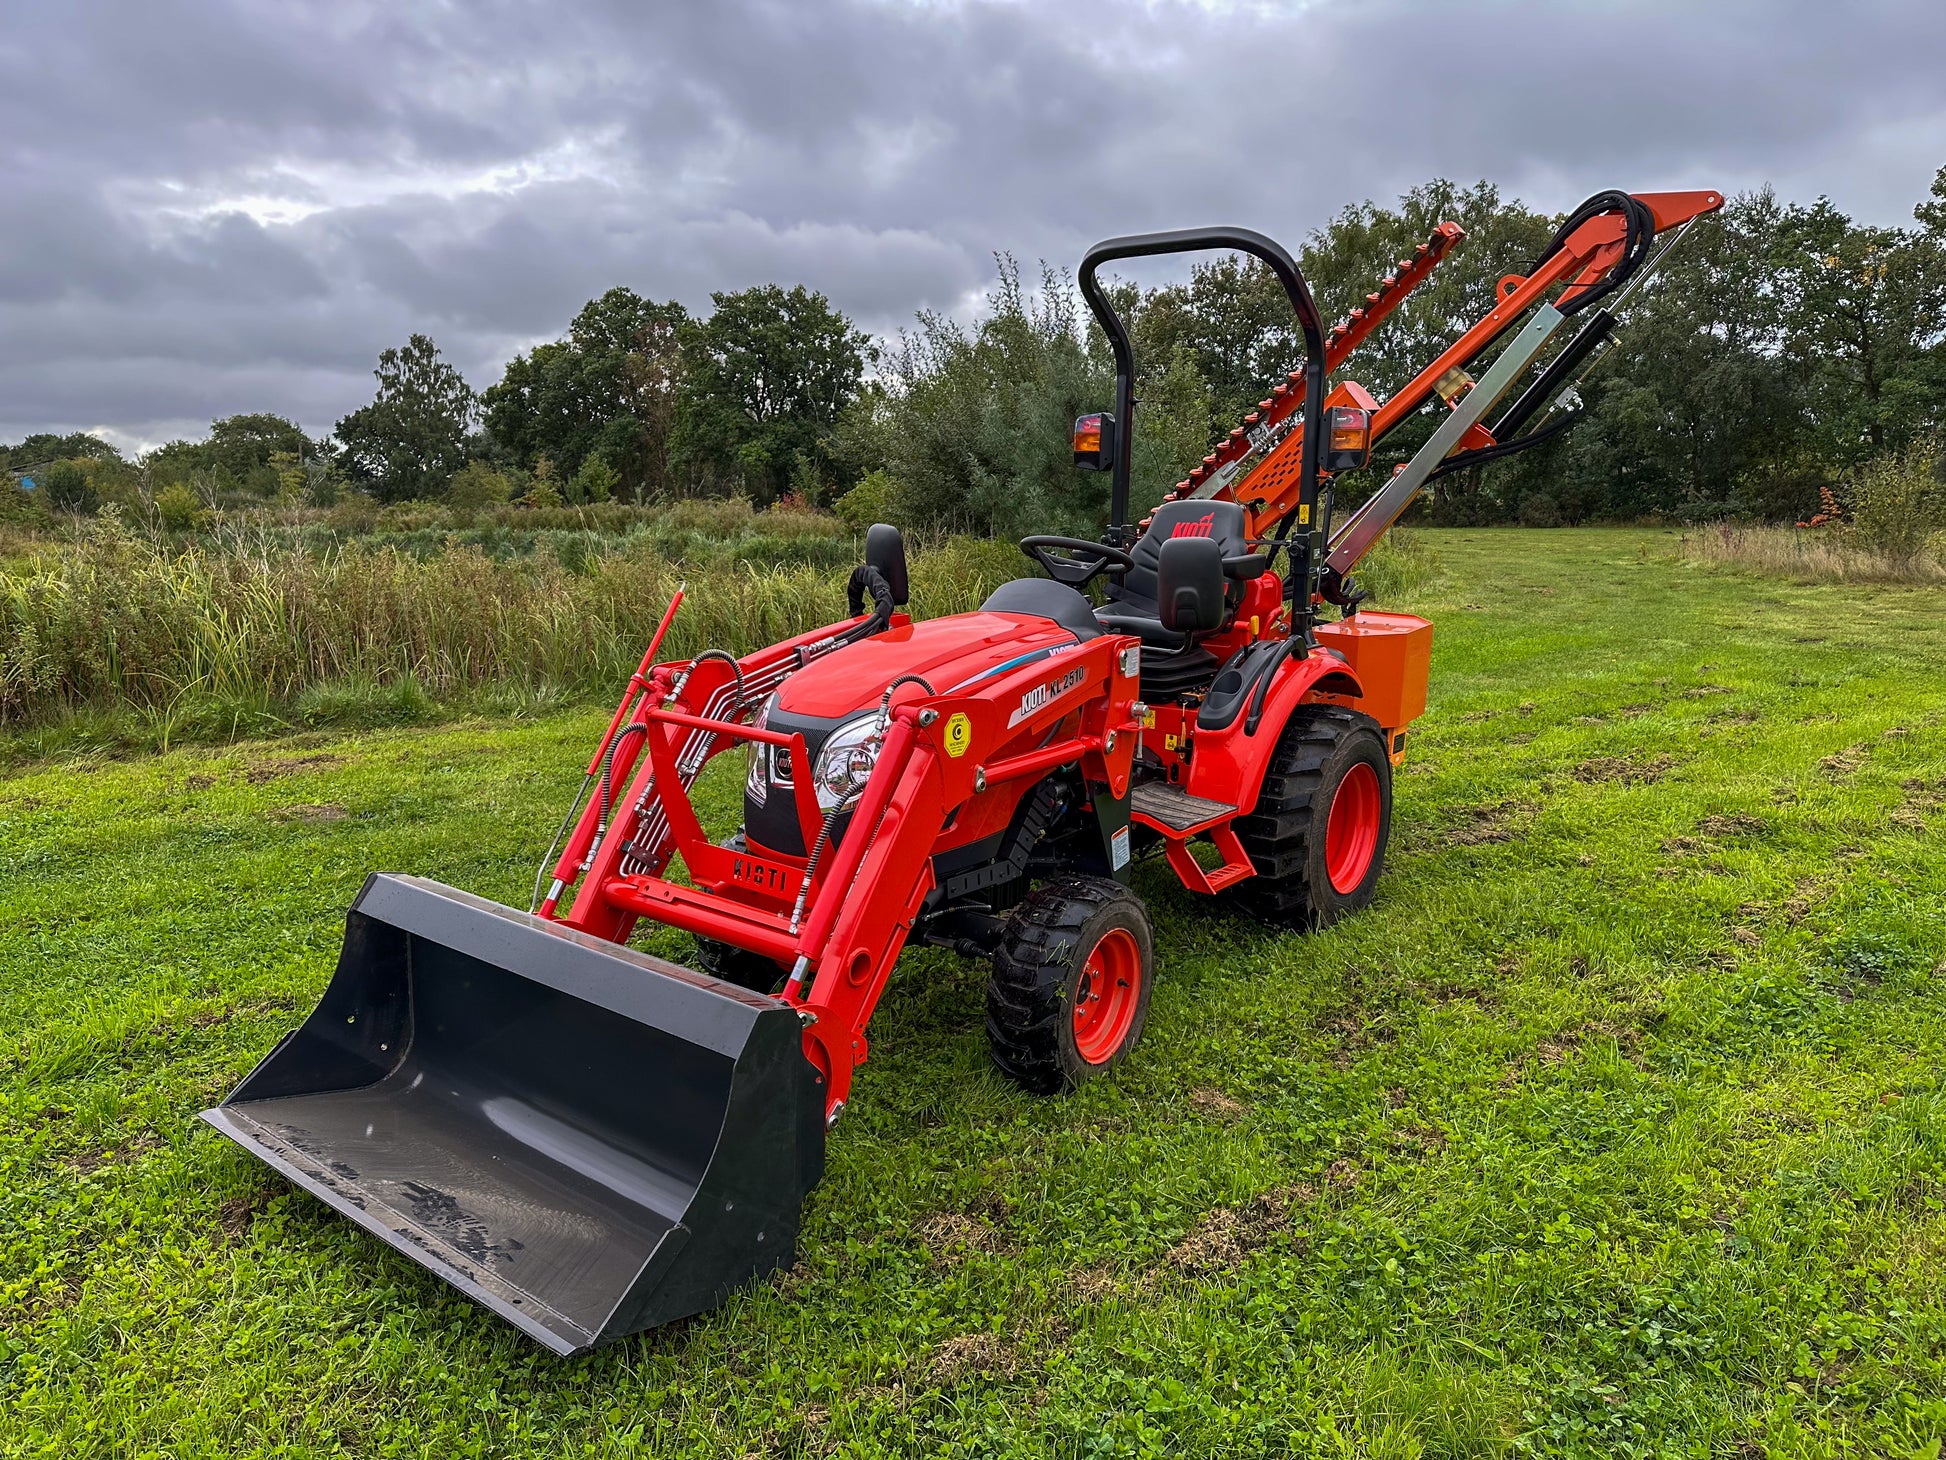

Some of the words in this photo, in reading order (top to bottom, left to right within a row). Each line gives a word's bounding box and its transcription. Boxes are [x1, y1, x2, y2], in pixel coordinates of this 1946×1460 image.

[1171, 522, 1213, 538] KIOTI
[1049, 645, 1075, 656] KIO
[1021, 683, 1046, 715] KIOTI
[1050, 680, 1061, 698] KL
[1063, 666, 1084, 689] 2510
[734, 859, 786, 891] KIOTI
